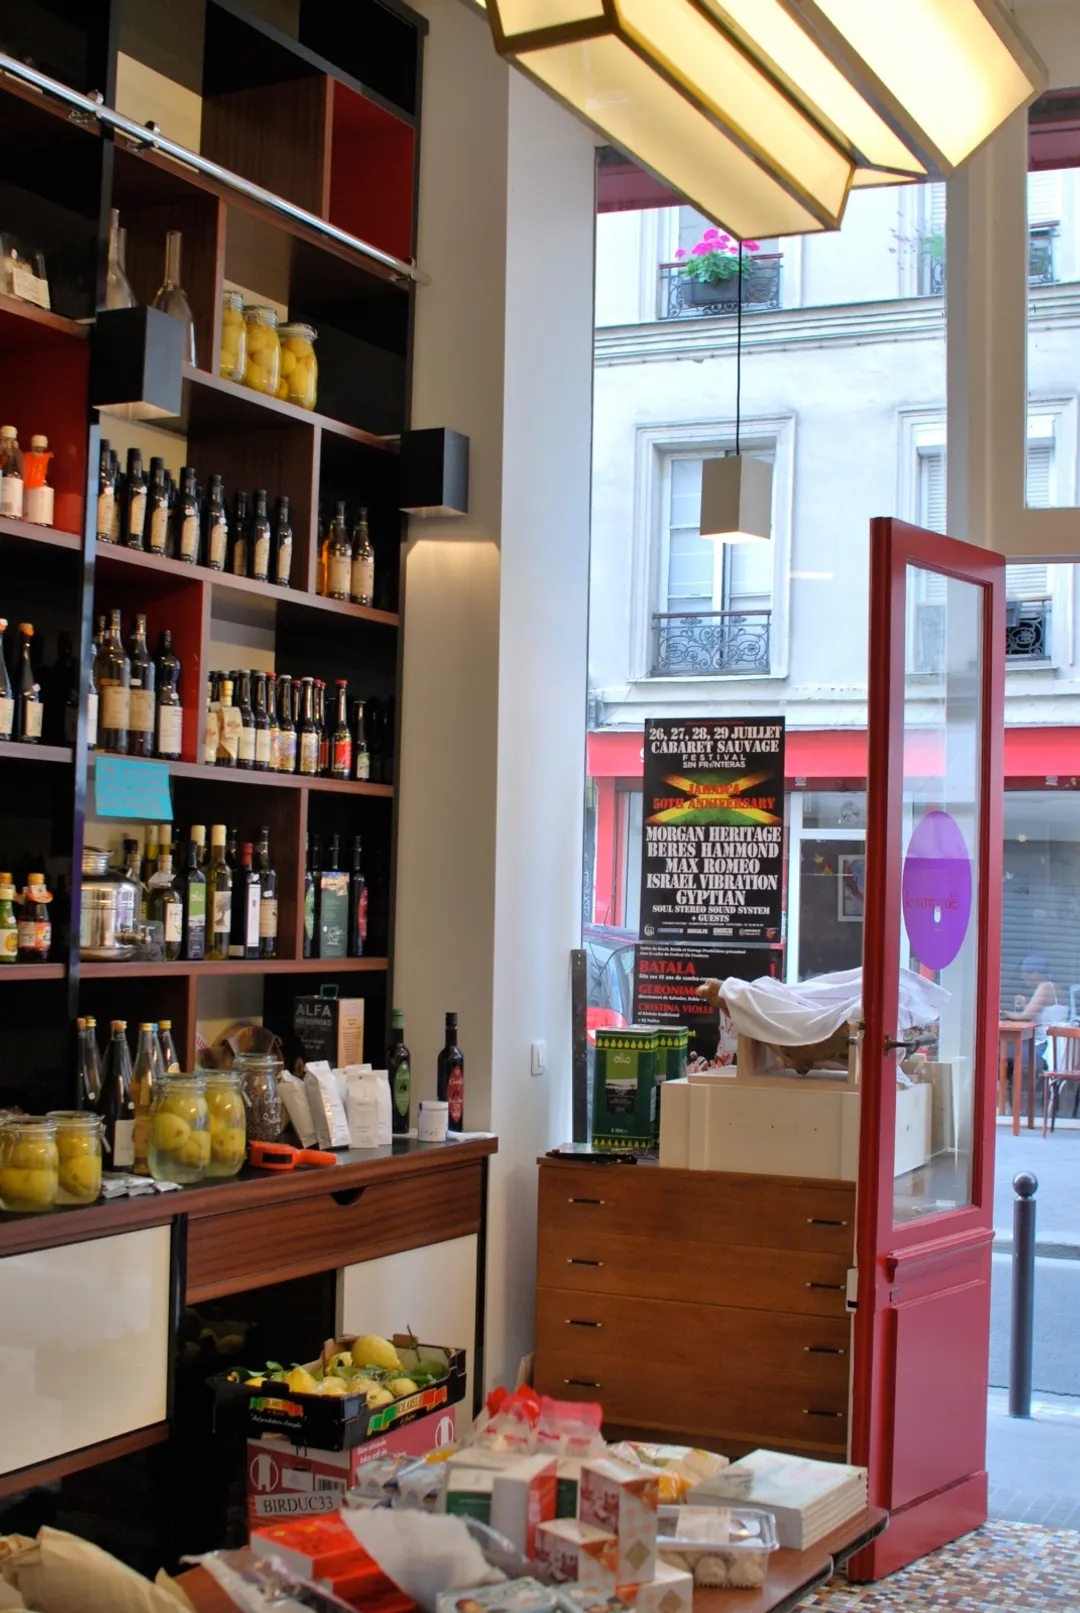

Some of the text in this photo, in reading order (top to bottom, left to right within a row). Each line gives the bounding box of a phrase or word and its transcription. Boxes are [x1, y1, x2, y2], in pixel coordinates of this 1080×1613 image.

[649, 726, 782, 741] 26, 27, 28, 29 JUILLET
[651, 740, 779, 754] CABARET SAUVAGE
[653, 797, 776, 809] 50TH ANNIVERSARY
[646, 826, 782, 842] MORGAN HERITAGE
[647, 842, 779, 858] BERES HAMMOND
[665, 858, 760, 874] MAX ROMEO
[646, 873, 778, 890] ISRAEL VIBRATION
[676, 890, 746, 906] GYPTIAN
[652, 905, 770, 915] SOUL STEREO SOUND SYSTEM
[697, 914, 730, 922] GUESTS
[639, 960, 696, 974] BATALA
[296, 1004, 332, 1016] ALFA
[638, 1002, 680, 1012] CRISTINA
[263, 1496, 333, 1514] BIRDUC33
